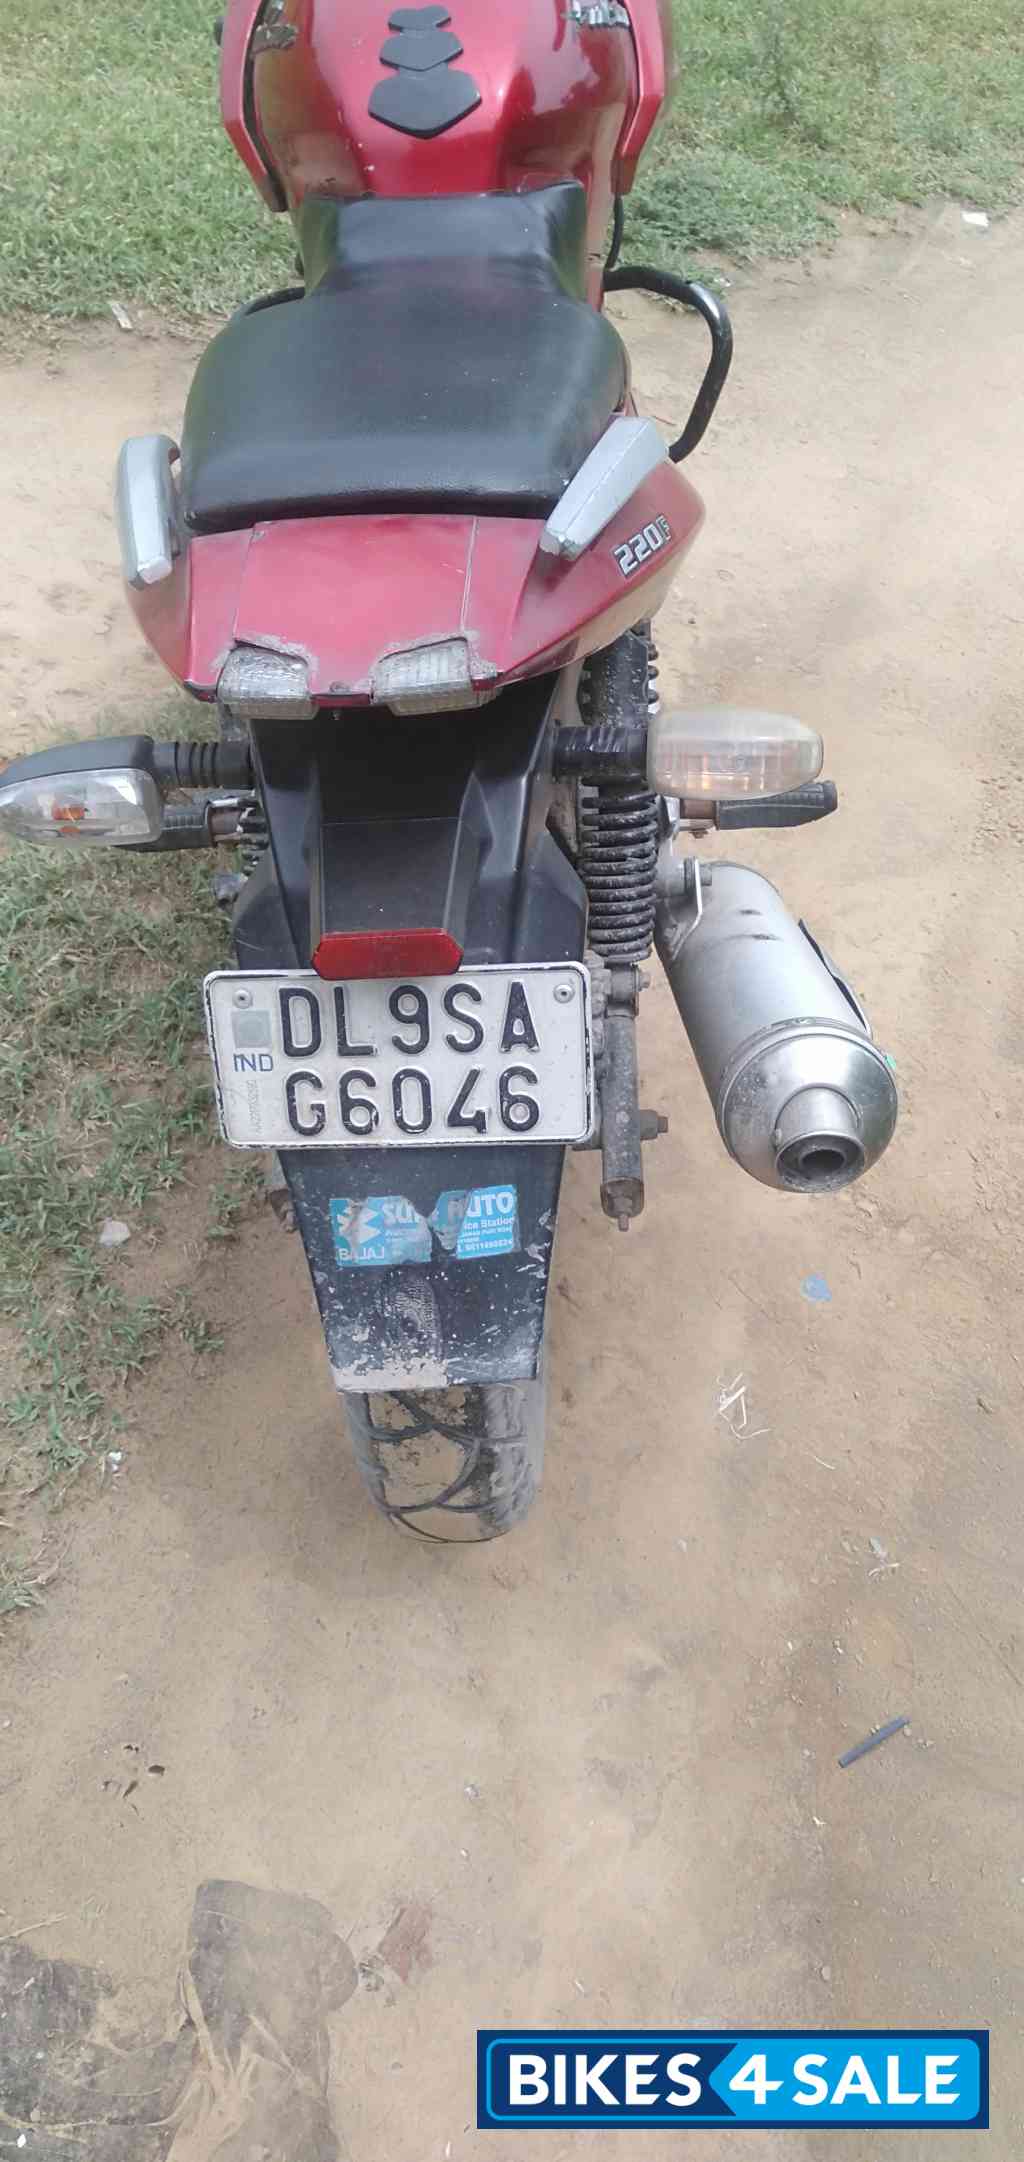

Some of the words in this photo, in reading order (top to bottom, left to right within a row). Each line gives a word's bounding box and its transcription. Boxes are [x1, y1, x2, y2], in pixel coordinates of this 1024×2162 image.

[279, 981, 540, 1057] DL9SA
[232, 1053, 274, 1072] IND
[285, 1066, 540, 1137] G6046
